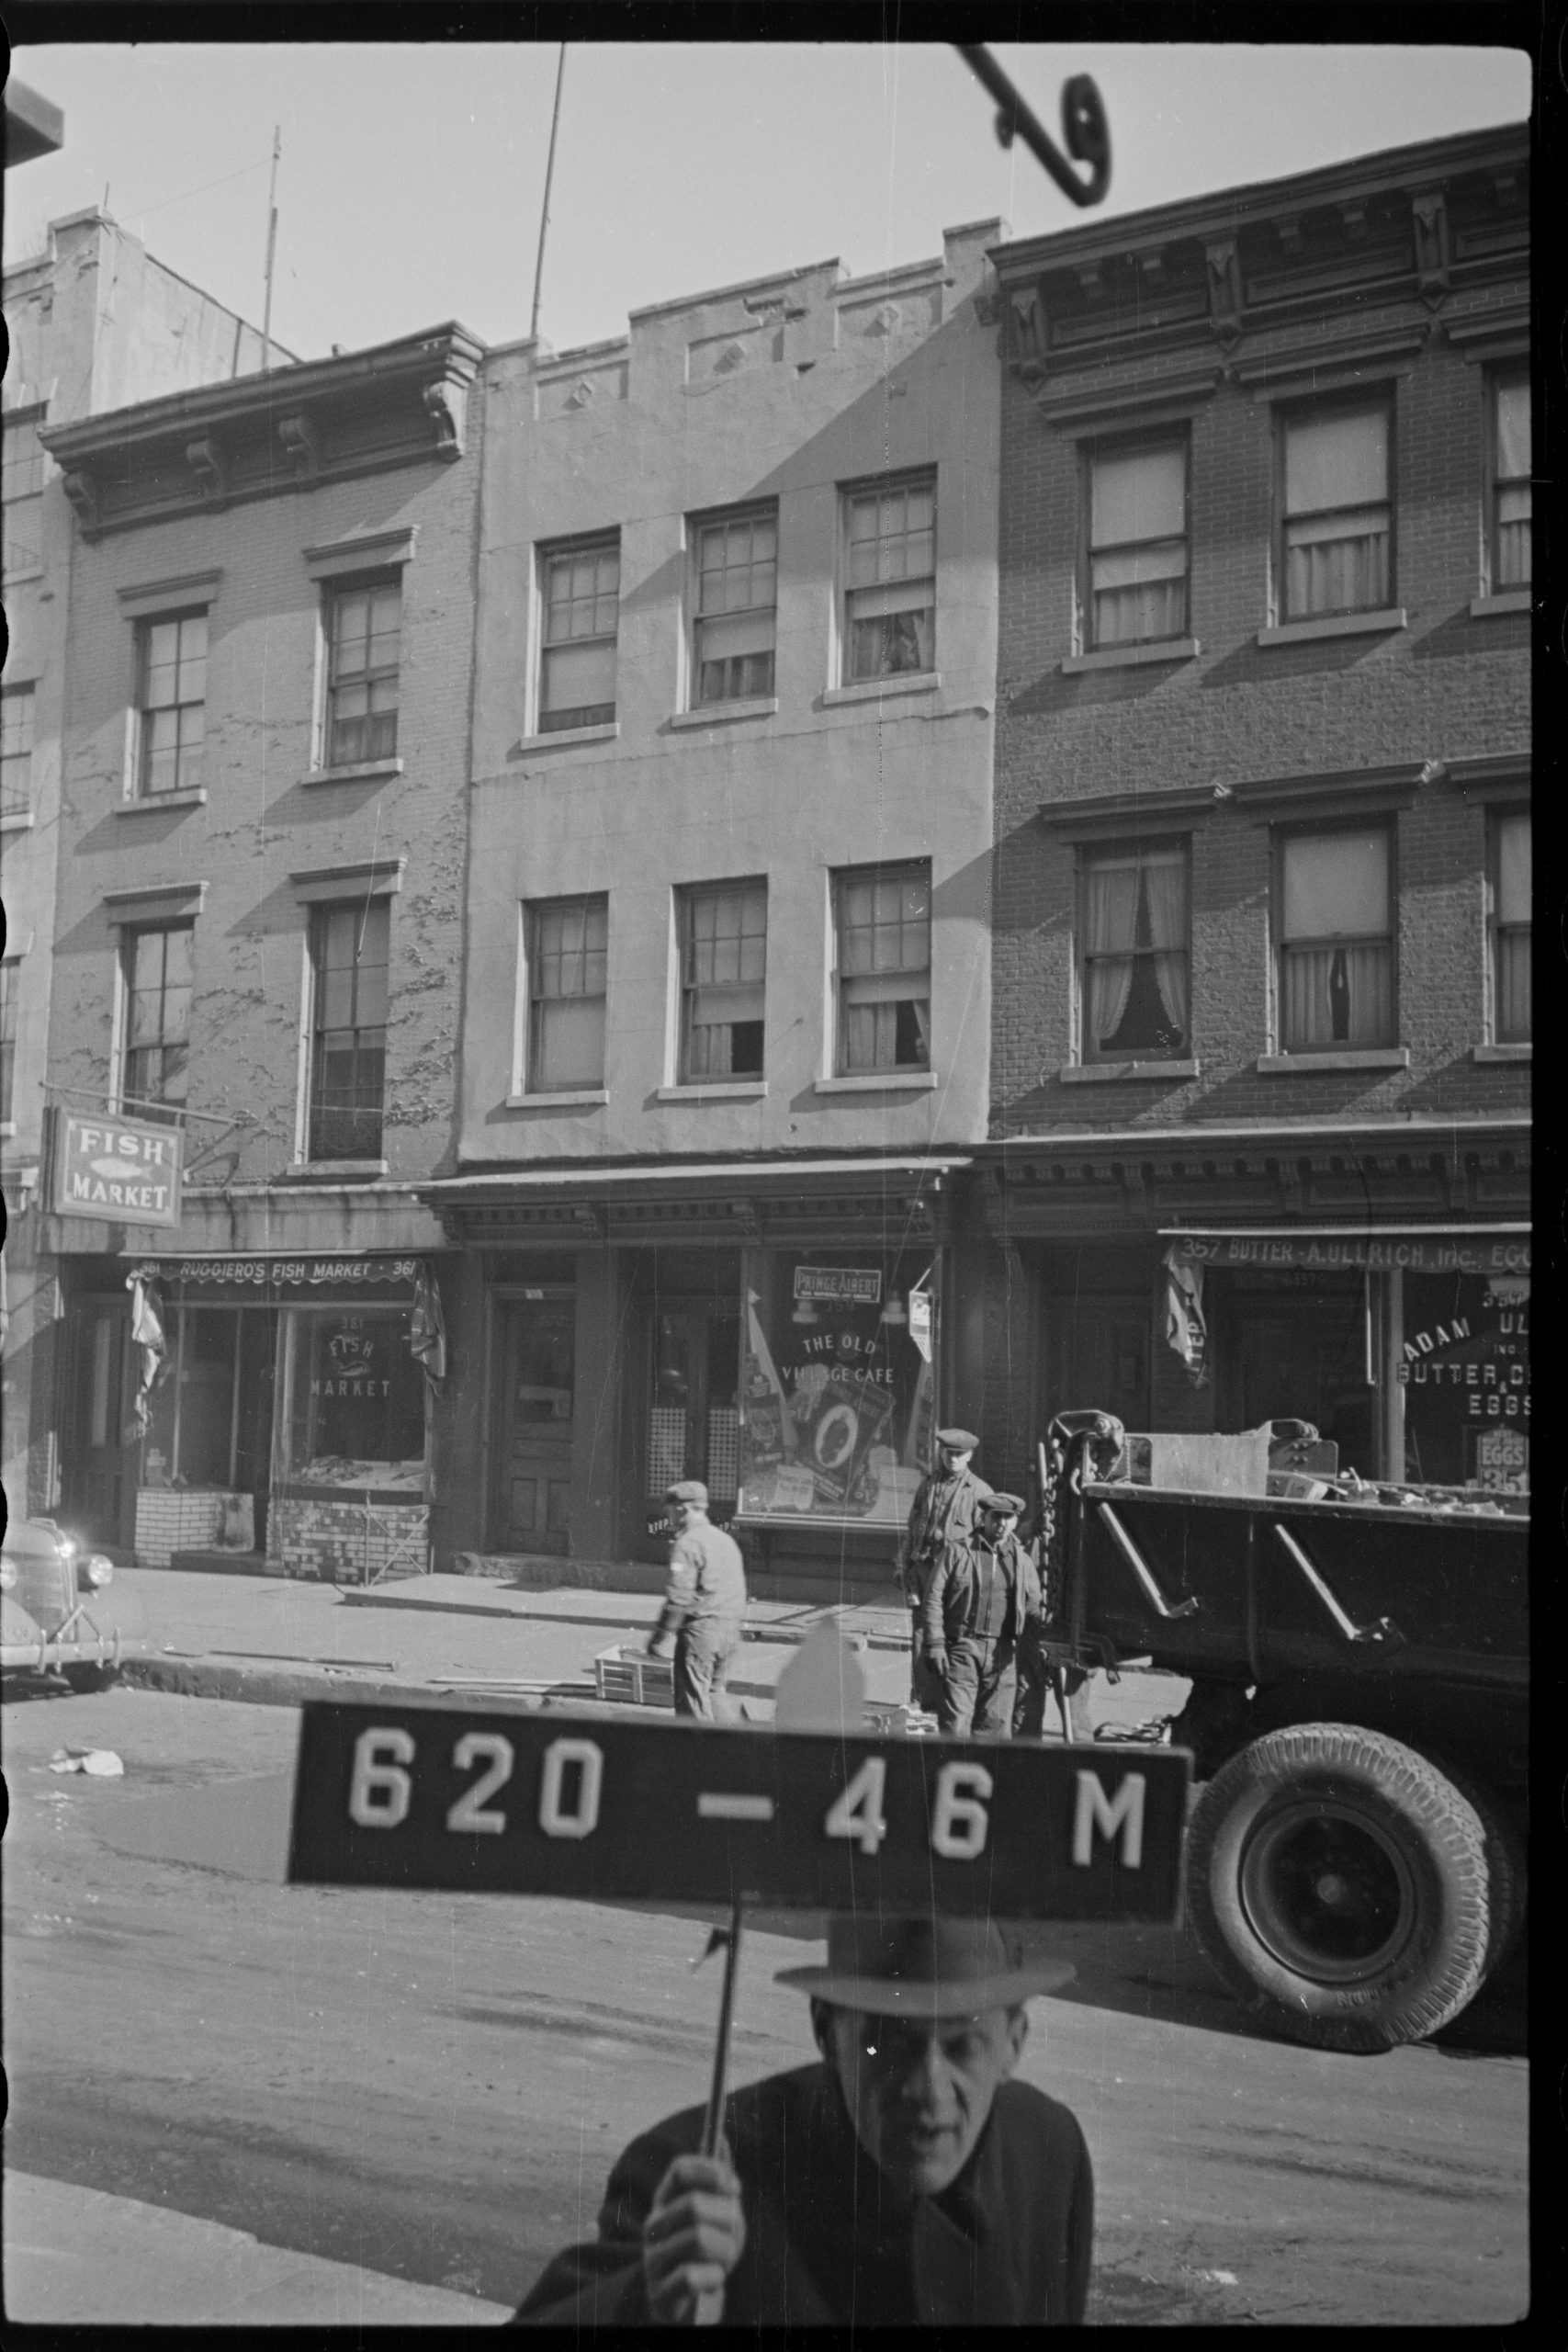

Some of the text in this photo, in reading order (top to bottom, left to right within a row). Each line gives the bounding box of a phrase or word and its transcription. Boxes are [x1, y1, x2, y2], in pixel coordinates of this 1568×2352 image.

[80, 1128, 164, 1165] FISH
[73, 1171, 168, 1210] MARKET
[1181, 1238, 1220, 1259] 357
[1228, 1238, 1292, 1261] BUTTER
[180, 1261, 265, 1278] RUGGIERO'S
[272, 1262, 306, 1278] FISH
[313, 1262, 371, 1278] MARKET
[392, 1261, 416, 1275] 361
[1483, 1291, 1523, 1308] 357
[329, 1334, 374, 1358] FISH
[803, 1334, 876, 1355] THE OLD
[1404, 1317, 1471, 1362] ADAM
[783, 1365, 895, 1384] VILLAGE CAFE
[310, 1379, 390, 1397] MARKET
[1482, 1445, 1524, 1466] EGGS
[348, 1725, 604, 1840] 620
[824, 1756, 995, 1859] 46
[1072, 1769, 1147, 1871] M
